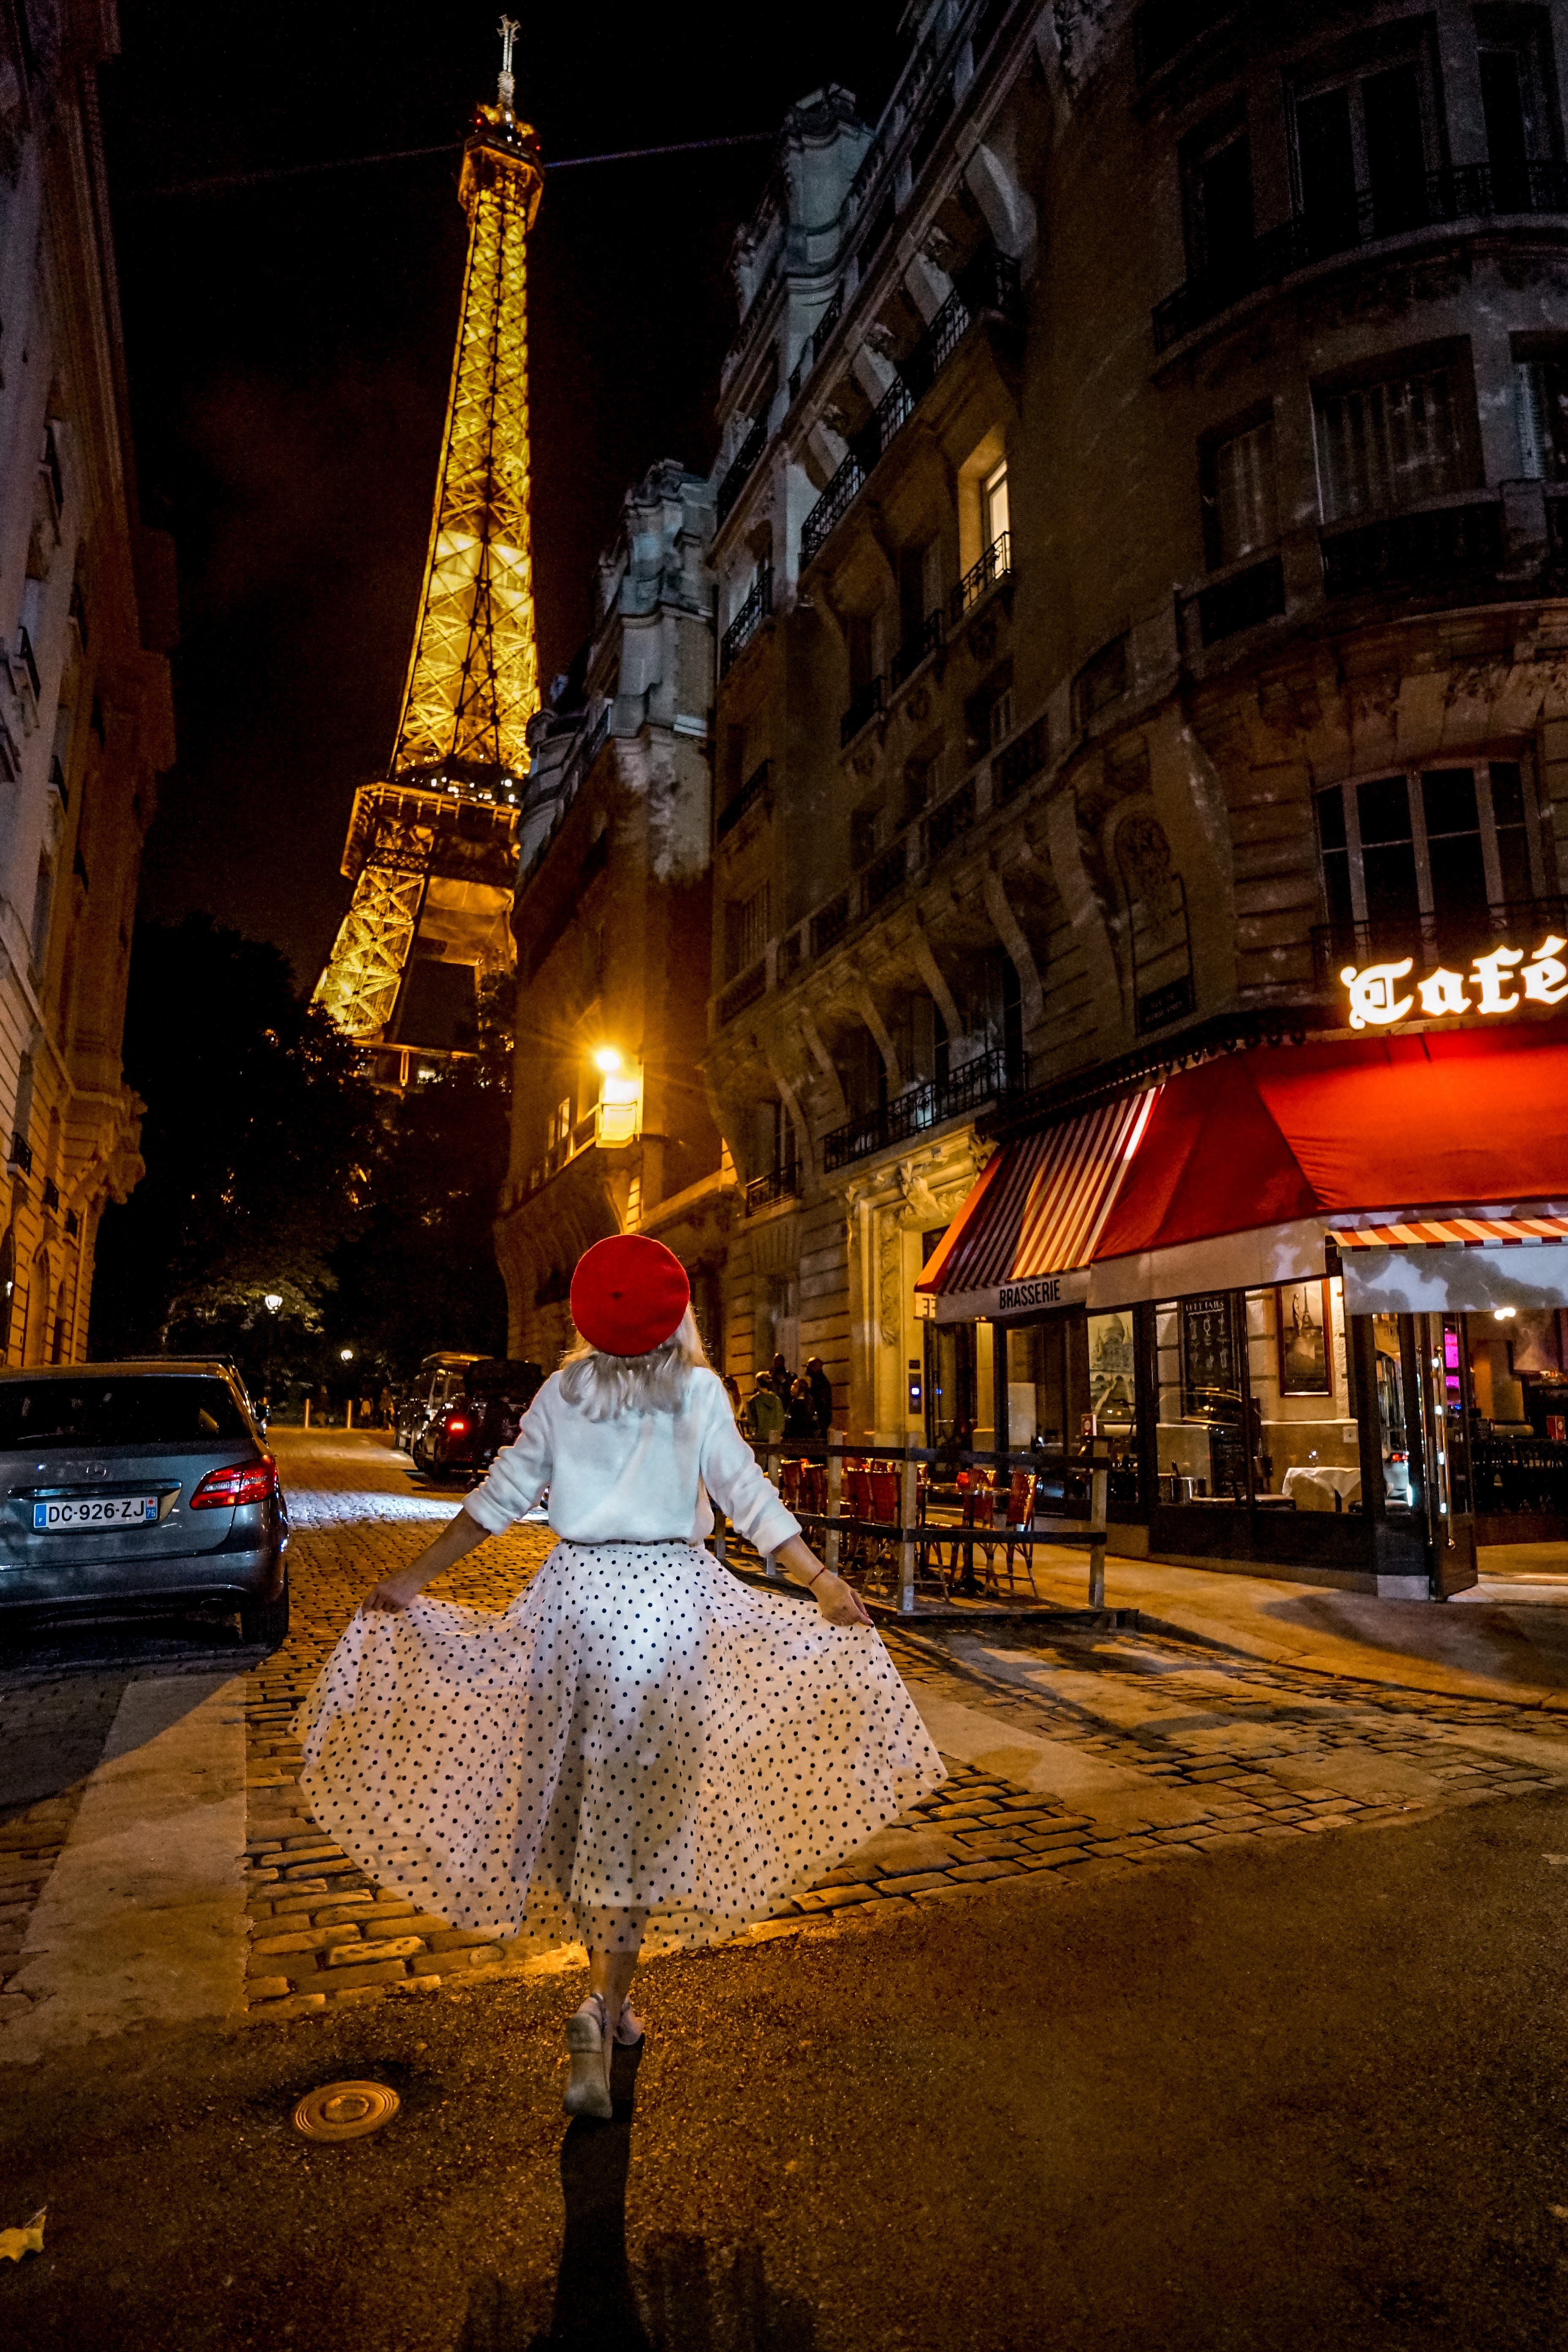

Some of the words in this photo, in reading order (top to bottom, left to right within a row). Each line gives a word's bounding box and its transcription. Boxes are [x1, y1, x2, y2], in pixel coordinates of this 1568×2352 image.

[1340, 934, 1568, 1029] Café
[1000, 1279, 1060, 1309] BRASSERIE
[49, 1500, 144, 1522] DC-926-ZJ
[147, 1509, 155, 1518] 75
